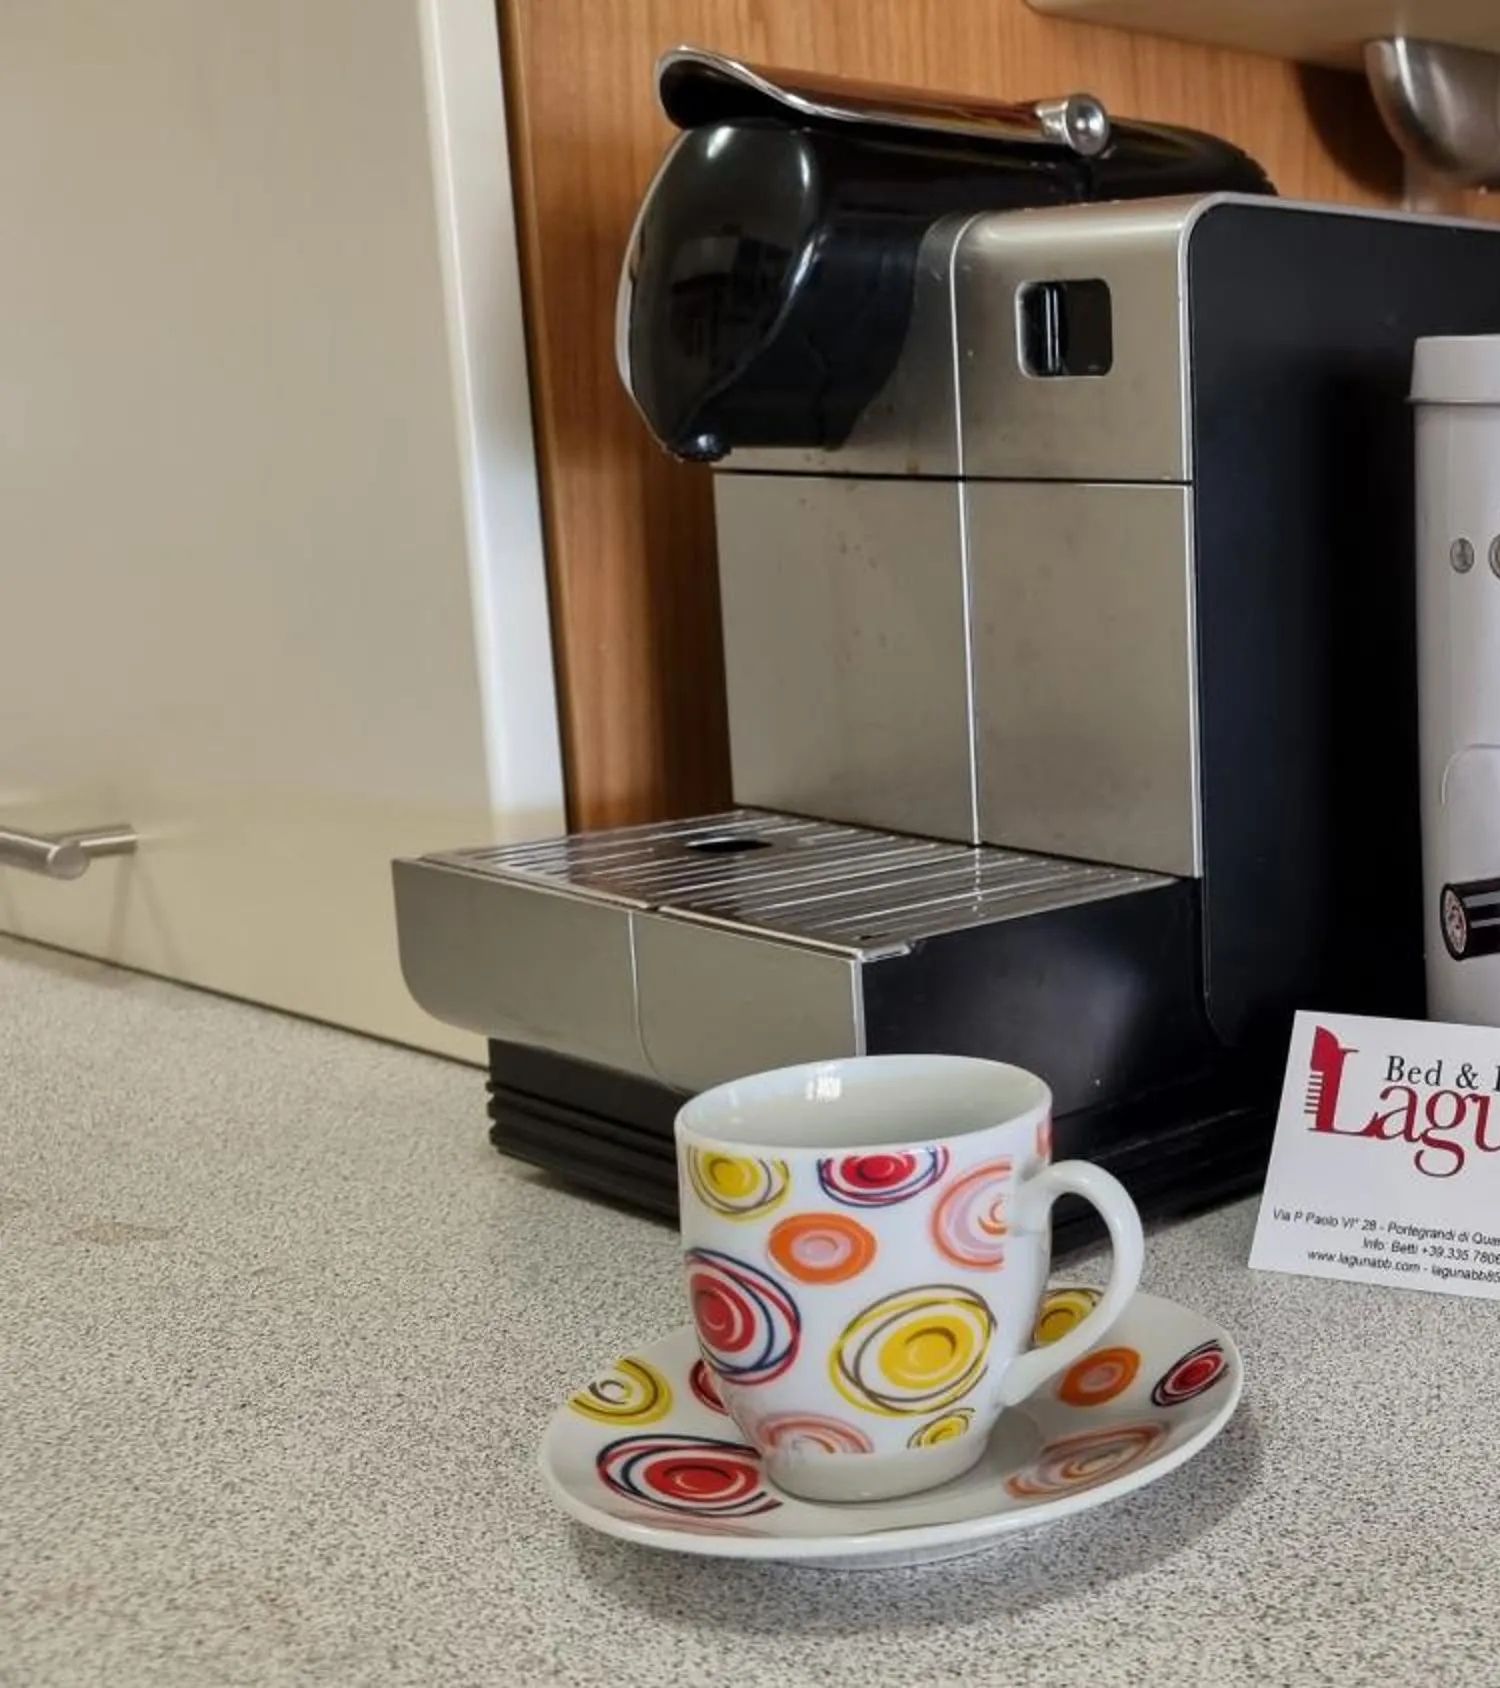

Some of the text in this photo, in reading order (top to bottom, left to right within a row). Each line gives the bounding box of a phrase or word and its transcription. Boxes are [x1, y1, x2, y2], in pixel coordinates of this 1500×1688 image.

[1384, 1055, 1442, 1087] Bed
[1455, 1062, 1480, 1090] &
[1273, 1207, 1291, 1222] Via
[1305, 1211, 1339, 1228] Paolo
[1361, 1219, 1377, 1232] 28
[1388, 1221, 1454, 1242] Portegrandi
[1457, 1231, 1470, 1244] di
[1307, 1251, 1420, 1272] www.lagunabb.com
[1422, 1244, 1469, 1262] +39.335
